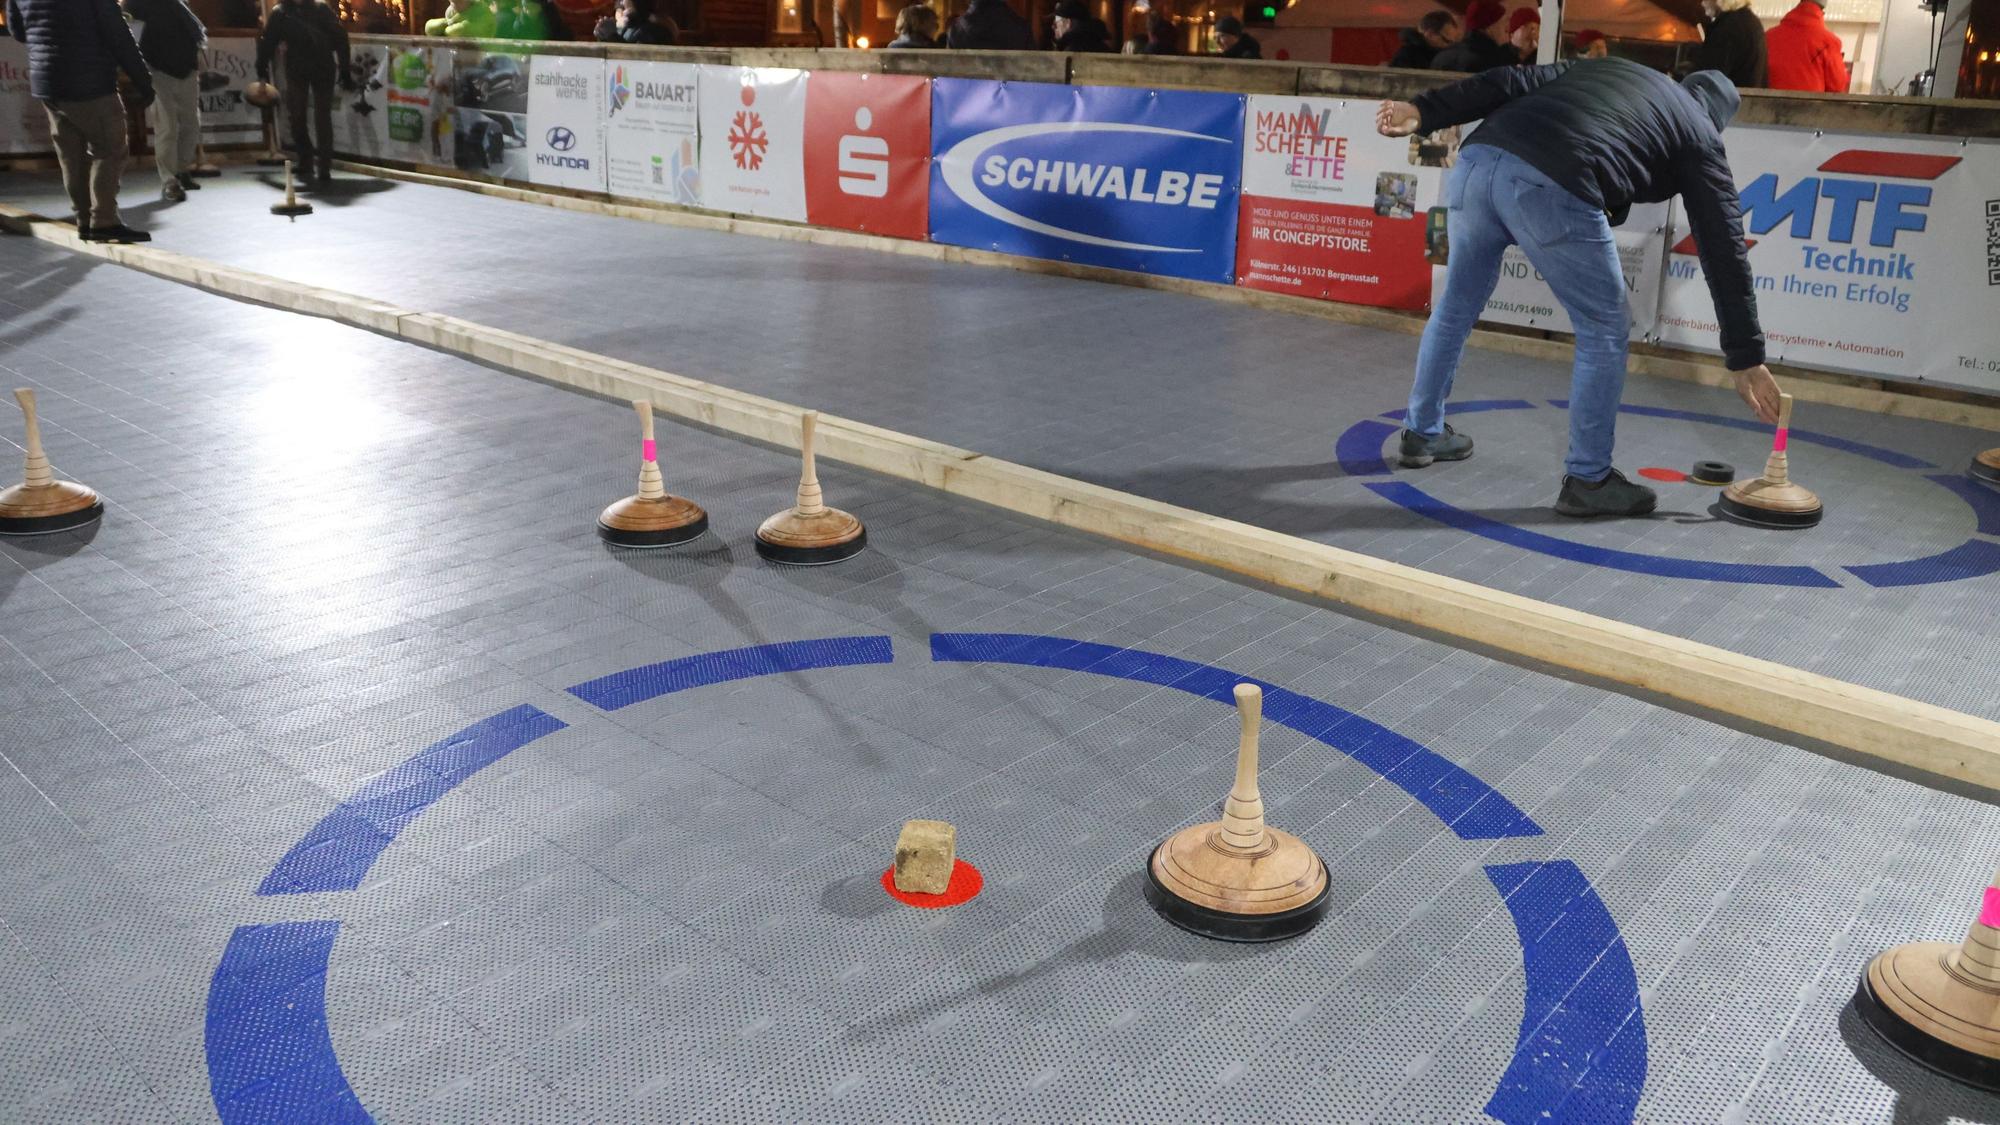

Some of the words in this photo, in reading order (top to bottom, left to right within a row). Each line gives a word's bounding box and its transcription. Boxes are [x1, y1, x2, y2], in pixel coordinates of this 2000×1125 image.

[535, 72, 587, 88] stahlhacke
[556, 87, 587, 99] werke
[635, 82, 695, 102] BAUART
[1257, 111, 1320, 133] MANN
[1255, 132, 1348, 158] SCHETTE
[536, 153, 589, 170] HYUNDAI
[980, 154, 1224, 209] SCHWALBE
[1253, 208, 1272, 218] MODE
[1273, 209, 1289, 219] UND
[1290, 211, 1320, 222] GENUSS
[1321, 215, 1345, 225] UNTER
[1348, 218, 1373, 228] EINEM
[1736, 173, 1933, 248] MTF
[1252, 226, 1270, 240] IHR
[1273, 229, 1371, 252] CONCEPTSTORE.
[1282, 263, 1296, 273] 246
[1302, 266, 1325, 277] 51702
[1328, 270, 1378, 284] Bergneustadt
[1503, 262, 1528, 279] ND
[1801, 246, 1915, 281] Technik
[1249, 271, 1302, 285] mannschette.de
[1667, 260, 1698, 280] Wir
[1783, 275, 1838, 298] Ihren
[1846, 283, 1911, 313] Erfolg
[1488, 300, 1553, 317] 02261/914909
[1835, 340, 1904, 360] Automation
[1958, 356, 1984, 370] Tel.:
